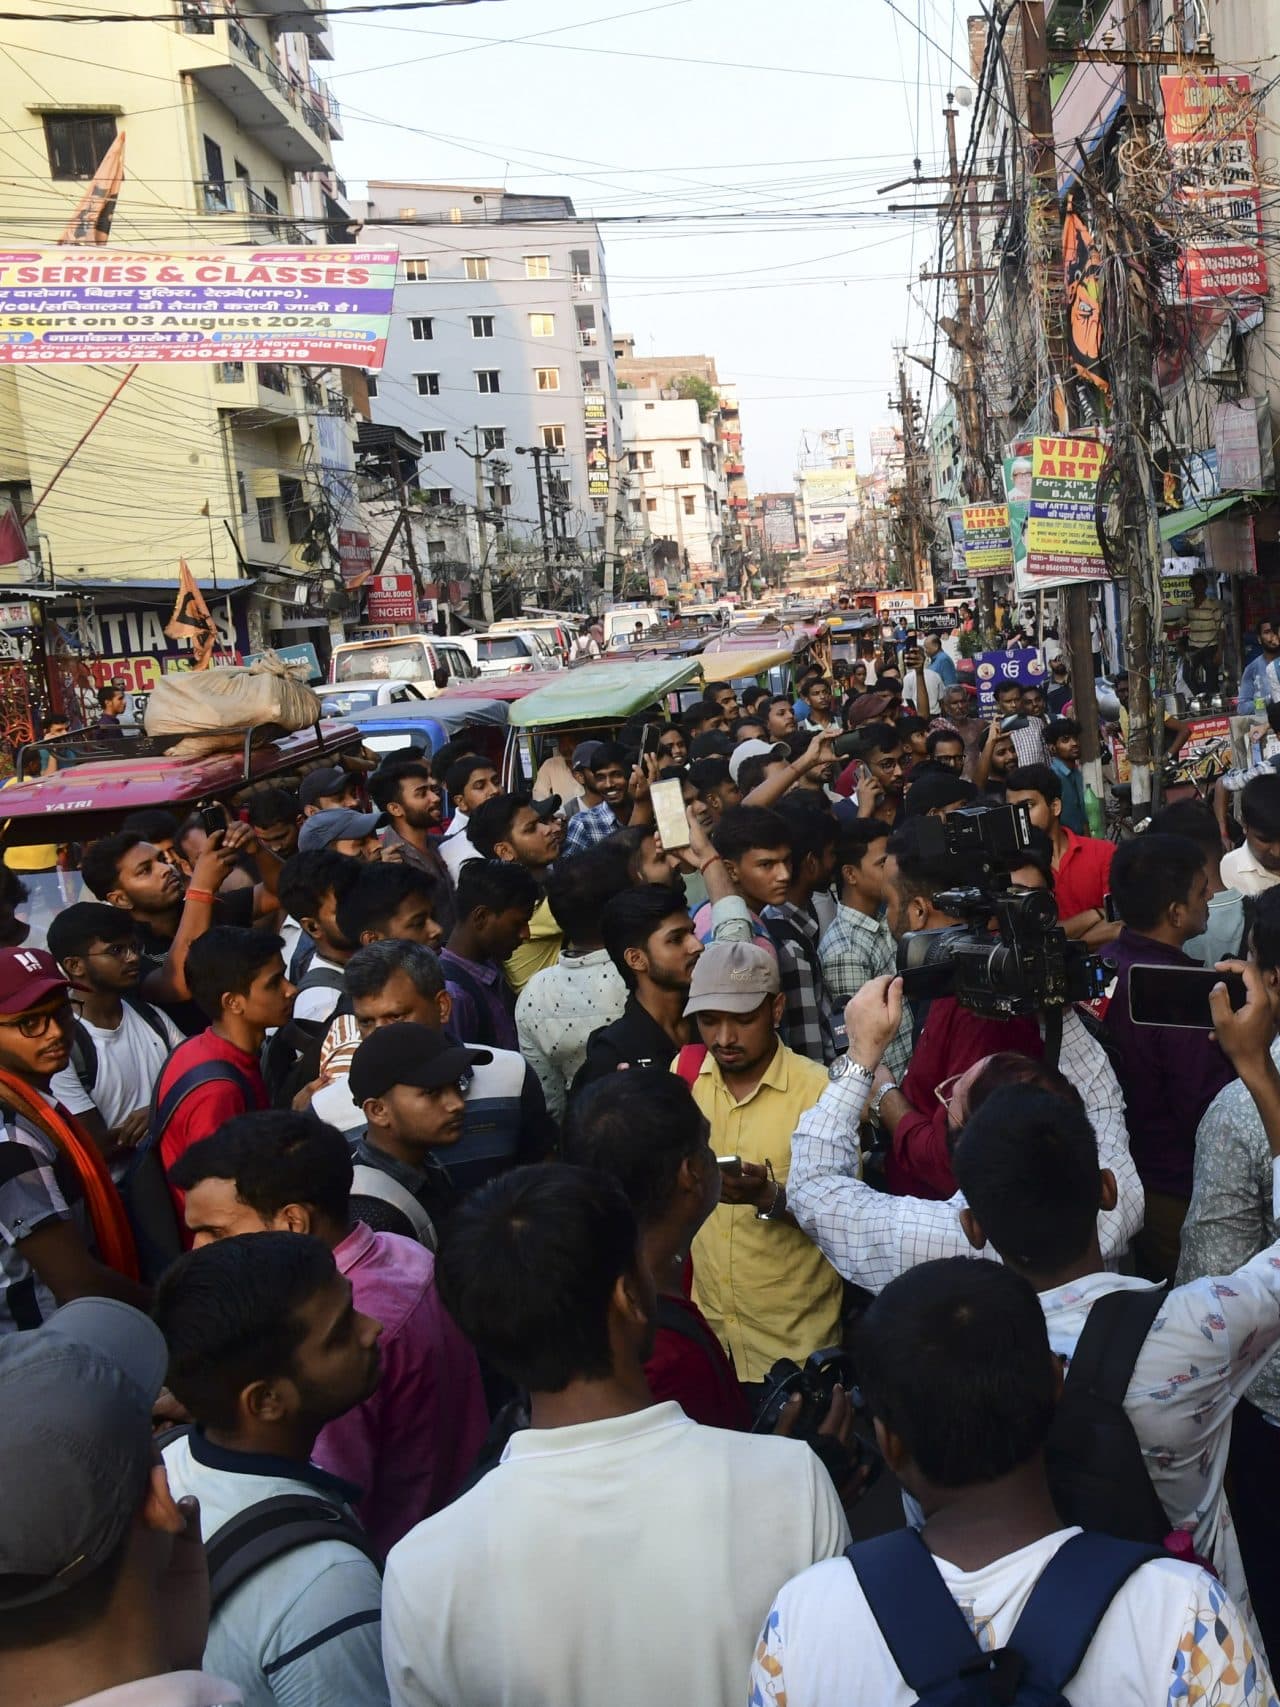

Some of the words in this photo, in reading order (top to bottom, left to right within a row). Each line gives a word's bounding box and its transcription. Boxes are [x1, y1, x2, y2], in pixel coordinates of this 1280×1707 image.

[17, 266, 146, 283] SERIES
[156, 266, 184, 282] &
[195, 265, 369, 285] CLASSES
[85, 286, 133, 298] बिहार
[137, 301, 163, 312] की
[284, 301, 331, 313] जाती
[8, 315, 77, 327] Start
[83, 317, 117, 326] on
[123, 315, 154, 326] 03
[161, 316, 262, 330] August
[267, 316, 332, 328] 2024
[263, 341, 300, 350] Naya
[303, 341, 330, 349] Tola
[333, 341, 377, 353] Patna
[965, 507, 1006, 518] VIJAY
[966, 518, 1006, 529] ARTS
[393, 590, 412, 598] BOOKS
[379, 607, 413, 618] NCERT
[45, 800, 93, 812] YATRI
